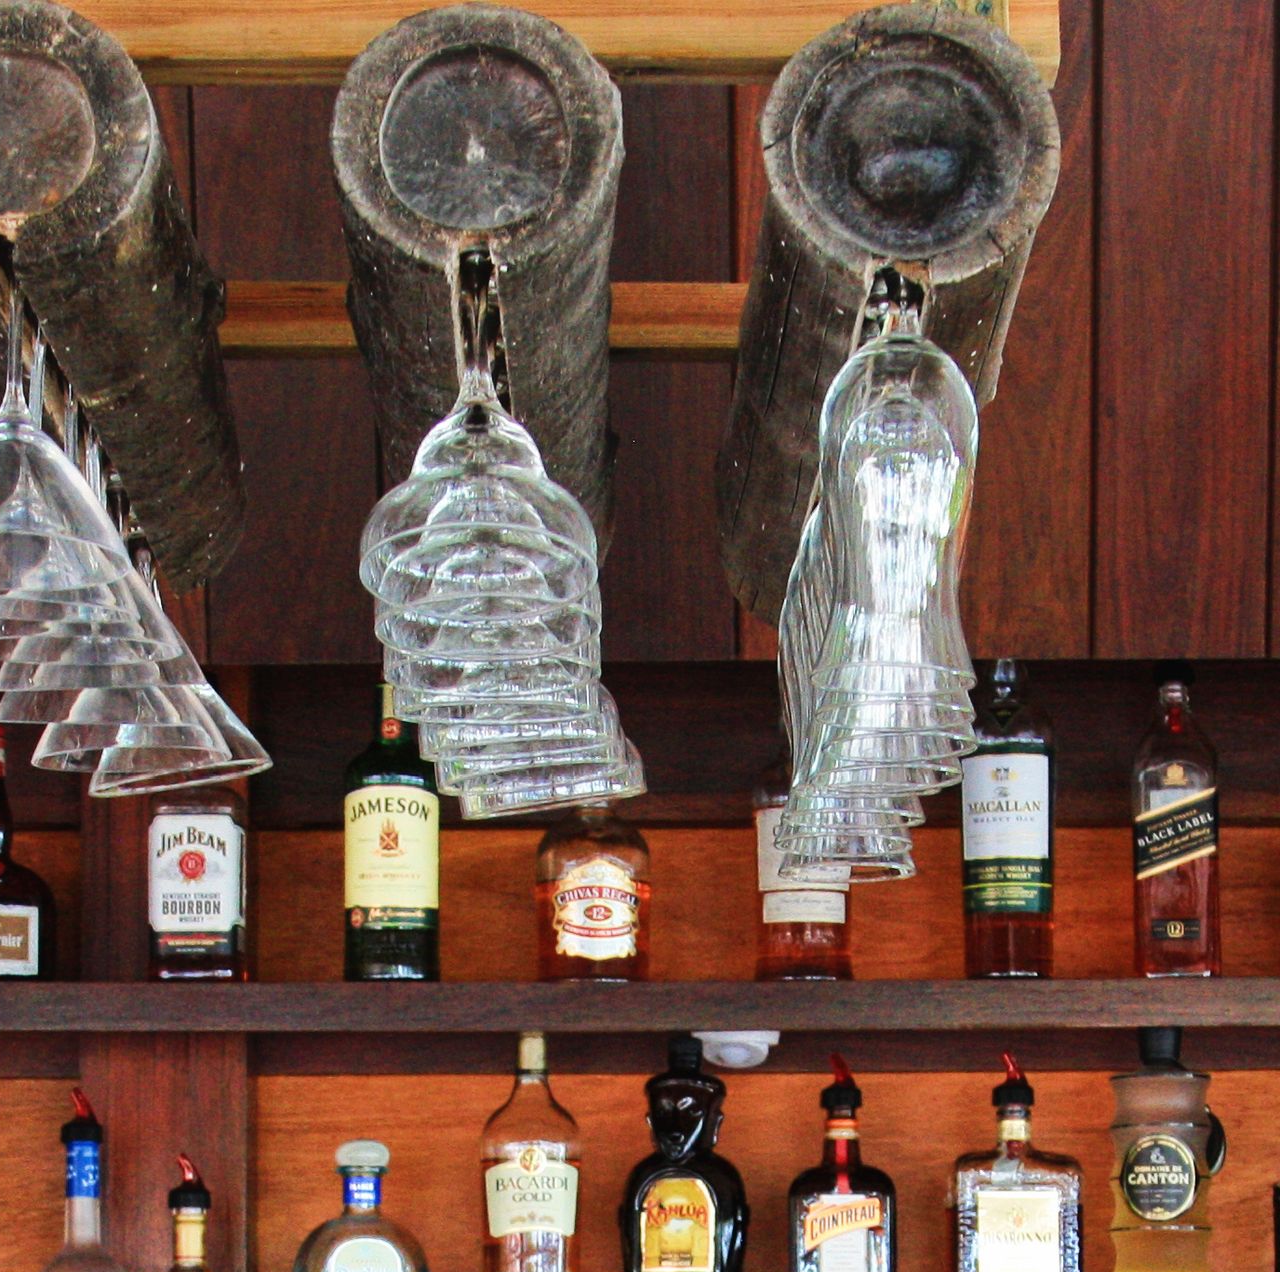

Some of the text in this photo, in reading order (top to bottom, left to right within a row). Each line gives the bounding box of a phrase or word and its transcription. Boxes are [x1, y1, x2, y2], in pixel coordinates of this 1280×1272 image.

[350, 796, 430, 823] JAMESON
[967, 801, 1042, 815] MACALLAN
[1137, 812, 1214, 847] BLACK LABEL
[156, 826, 227, 858] JIM BEAM
[556, 887, 637, 907] CHIVAS REGAL
[162, 901, 221, 915] BOURBON
[592, 907, 605, 920] 12
[496, 1174, 569, 1192] BACARDI
[1128, 1172, 1190, 1185] CANTON
[512, 1192, 553, 1203] GOLD
[810, 1205, 878, 1241] COINTREAU
[982, 1231, 1053, 1245] DISARONNO
